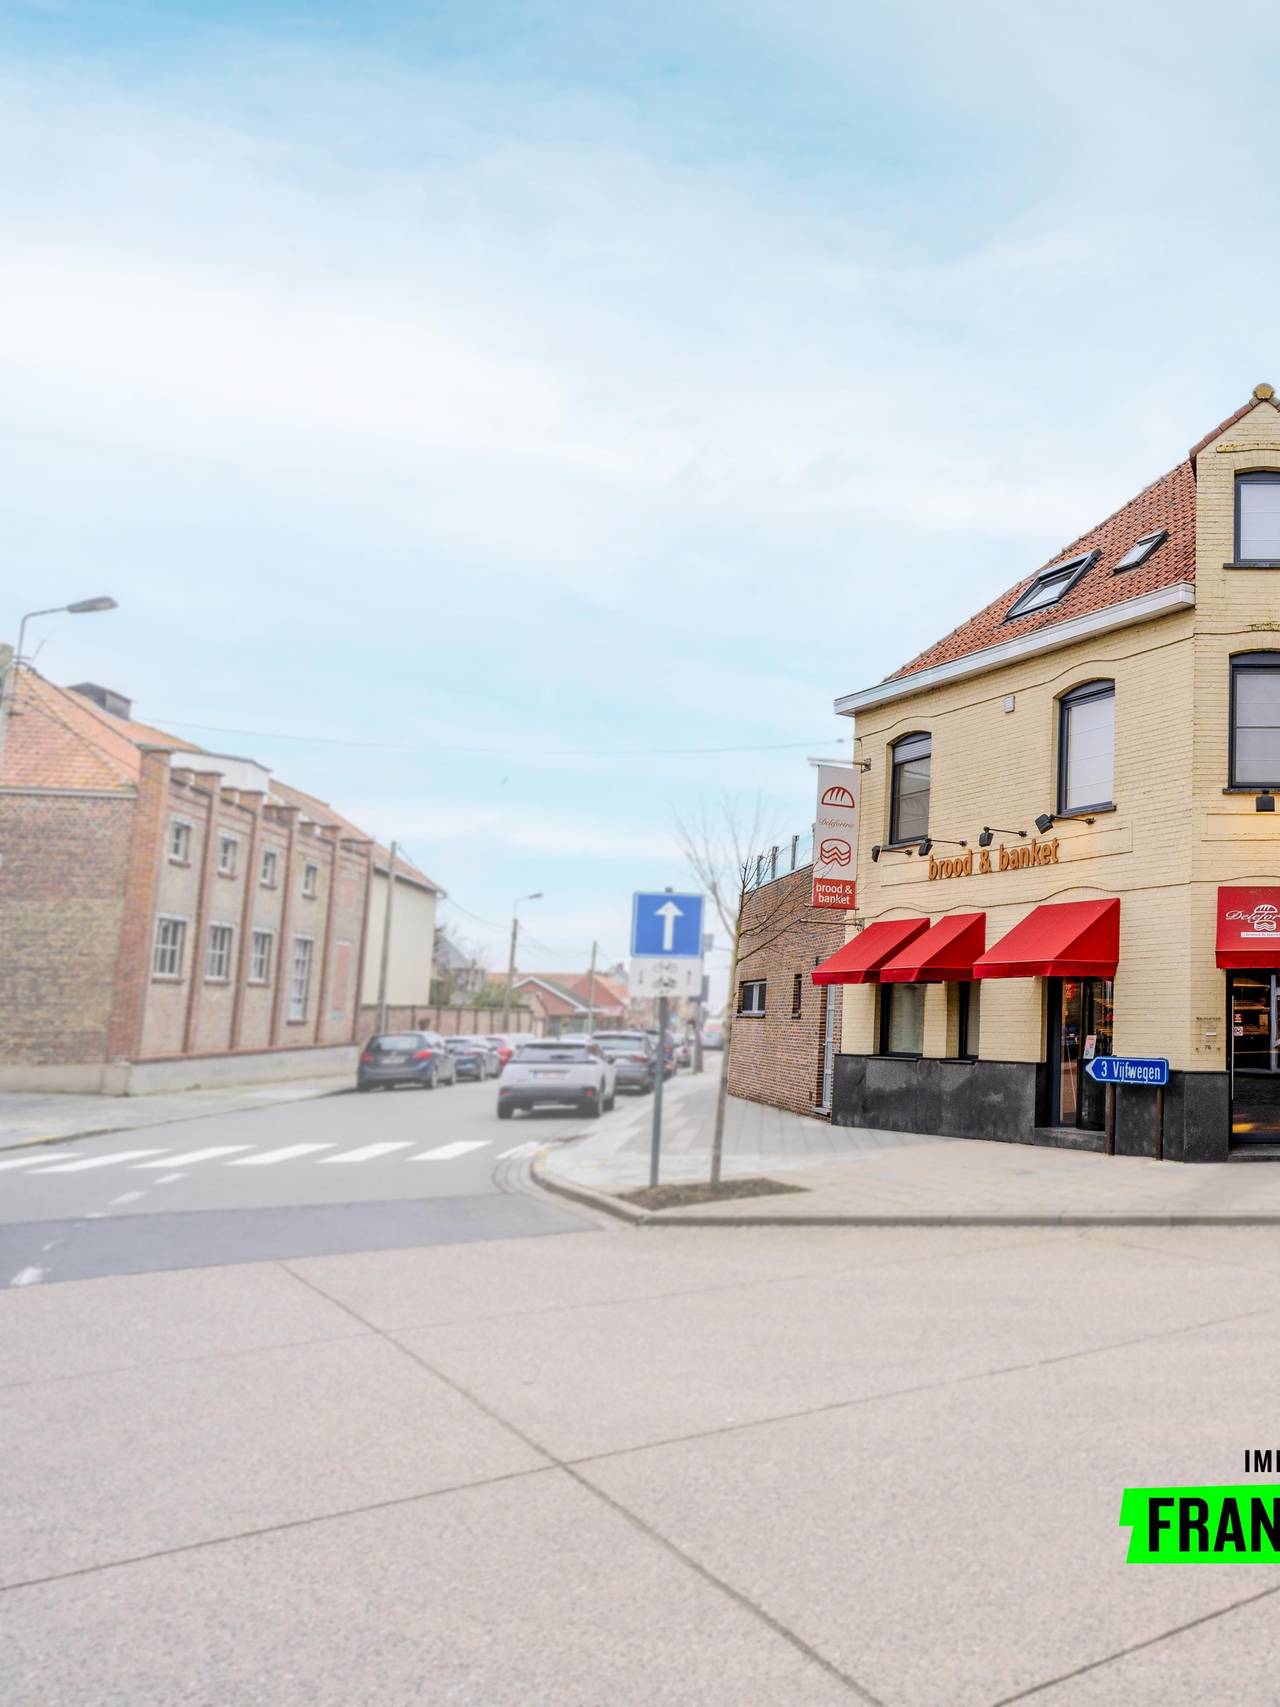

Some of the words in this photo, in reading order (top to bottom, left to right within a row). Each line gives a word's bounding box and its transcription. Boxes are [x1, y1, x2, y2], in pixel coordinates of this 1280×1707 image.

[928, 848, 973, 880] brood
[979, 849, 992, 873] &
[998, 836, 1060, 871] banket
[816, 883, 842, 893] brood
[845, 885, 853, 894] &
[818, 893, 850, 904] banket
[1101, 1061, 1108, 1077] 3
[1112, 1061, 1161, 1083] Vijfwegen
